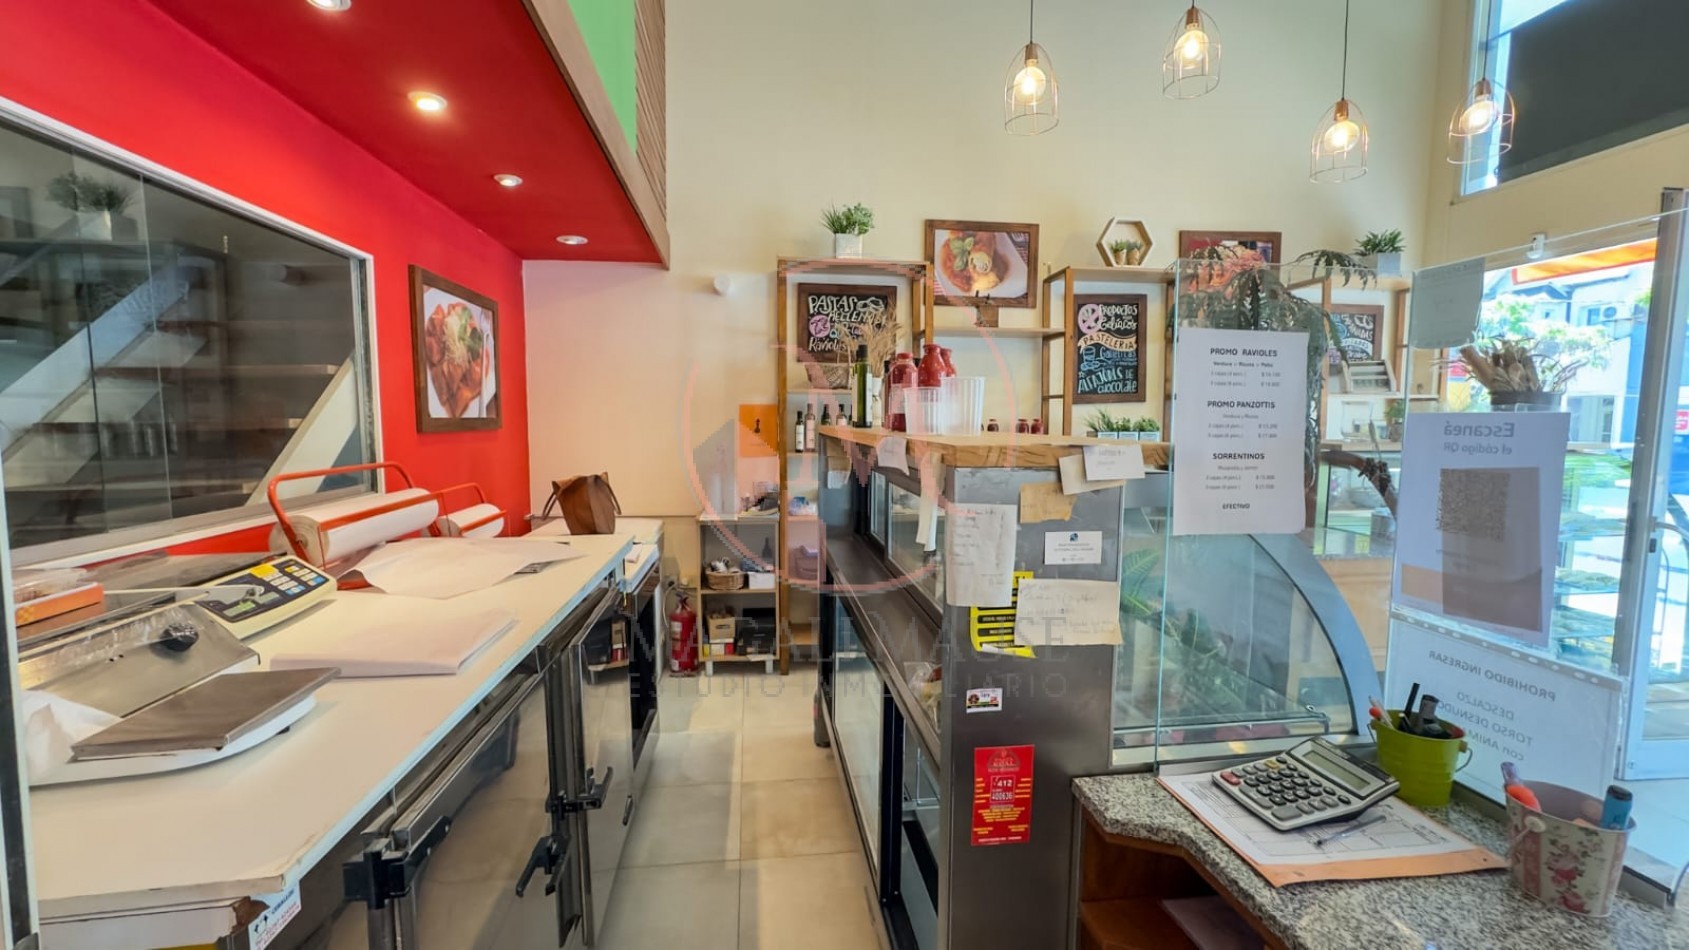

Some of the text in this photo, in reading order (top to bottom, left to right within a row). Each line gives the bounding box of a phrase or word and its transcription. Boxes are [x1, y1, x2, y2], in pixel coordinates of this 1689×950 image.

[808, 294, 857, 314] PASTAS
[1210, 348, 1277, 357] PROMO RAVIOLES
[1207, 400, 1275, 409] PROMO PANZOTTIS
